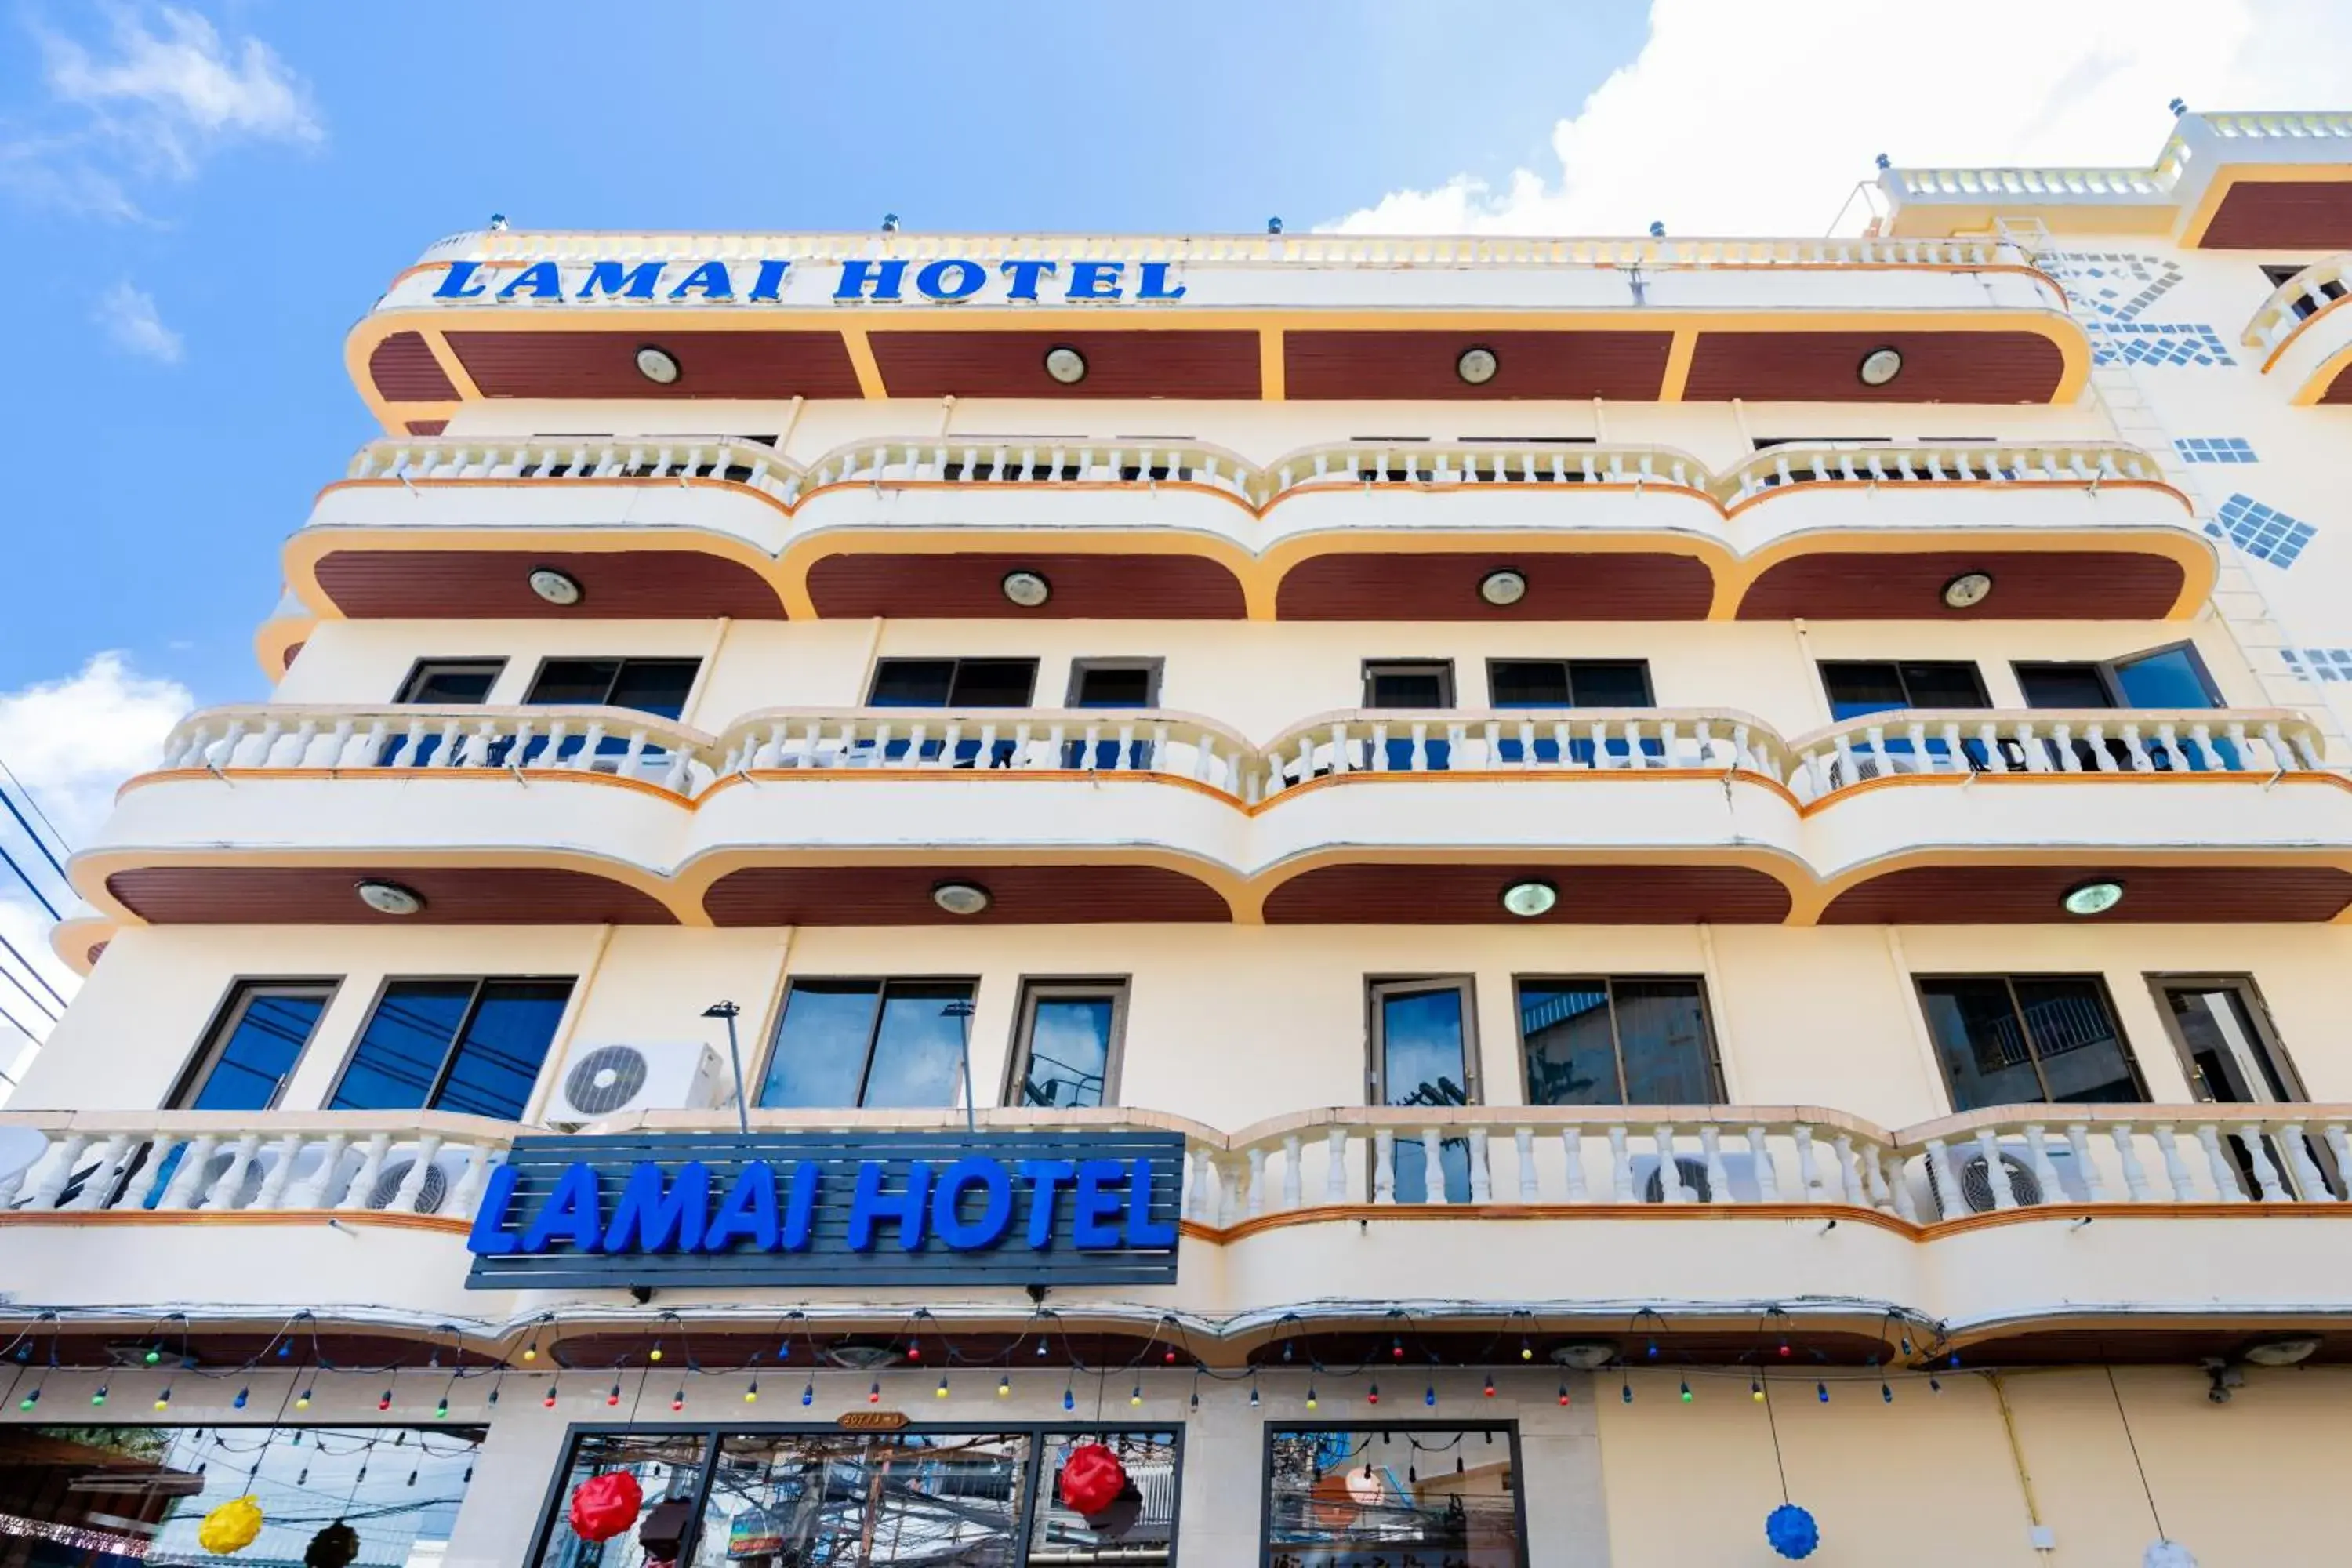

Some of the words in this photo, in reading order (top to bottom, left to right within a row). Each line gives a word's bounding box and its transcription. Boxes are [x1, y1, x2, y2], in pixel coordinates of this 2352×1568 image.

[432, 260, 790, 303] LAMAI
[833, 260, 1187, 300] HOTEL
[467, 1160, 822, 1254] LAMAI
[847, 1156, 1176, 1252] HOTEL
